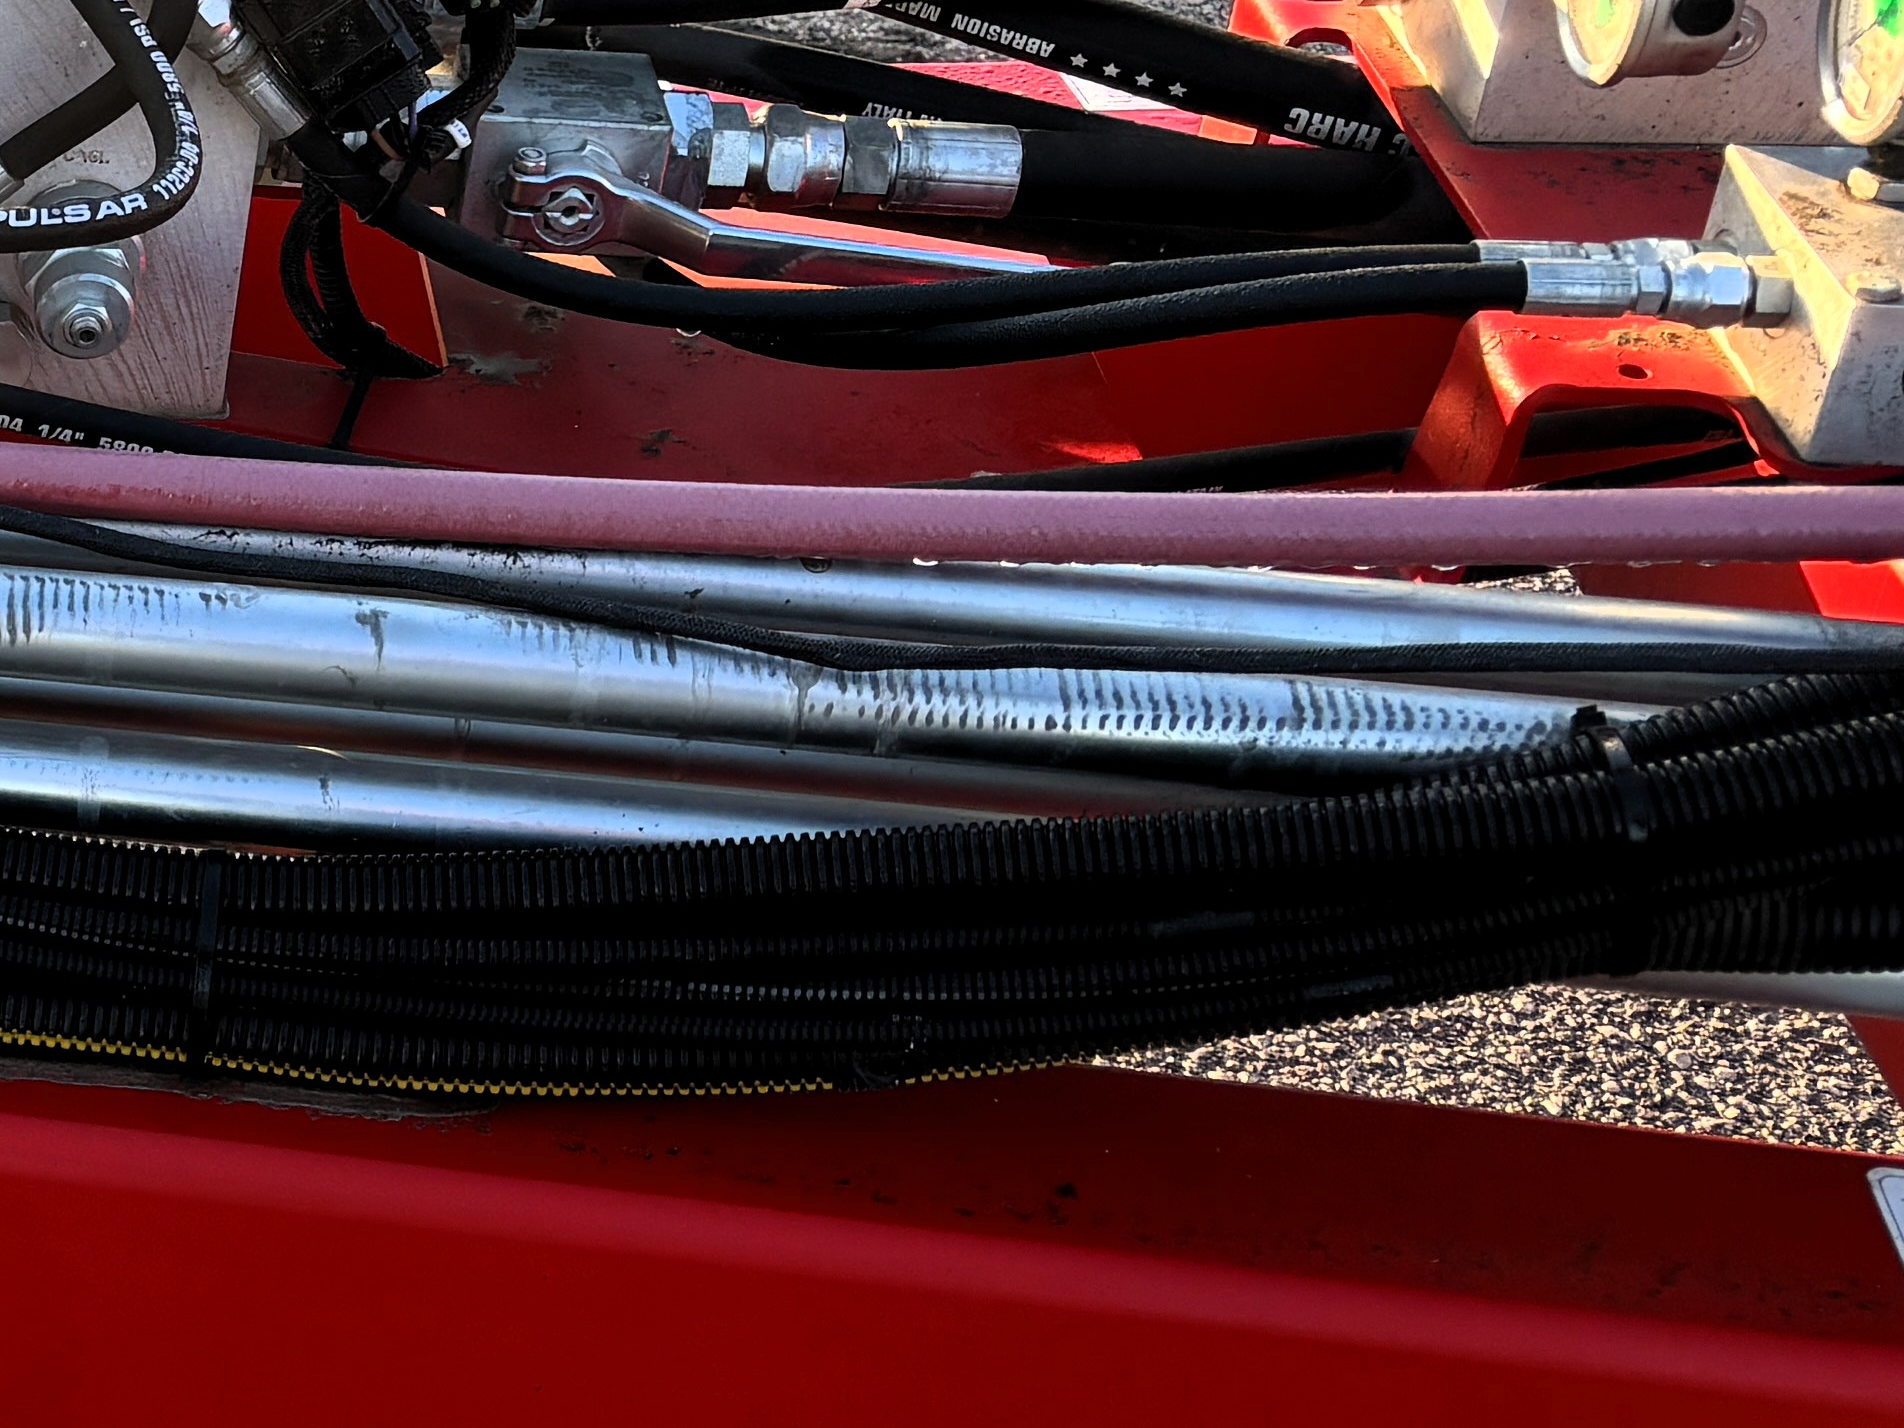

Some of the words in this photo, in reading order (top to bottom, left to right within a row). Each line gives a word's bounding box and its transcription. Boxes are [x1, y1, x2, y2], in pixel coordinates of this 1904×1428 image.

[951, 13, 1056, 58] ABRASION
[1283, 107, 1382, 152] HARC
[153, 140, 200, 200] 112CC-04
[37, 423, 85, 443] 1/4"
